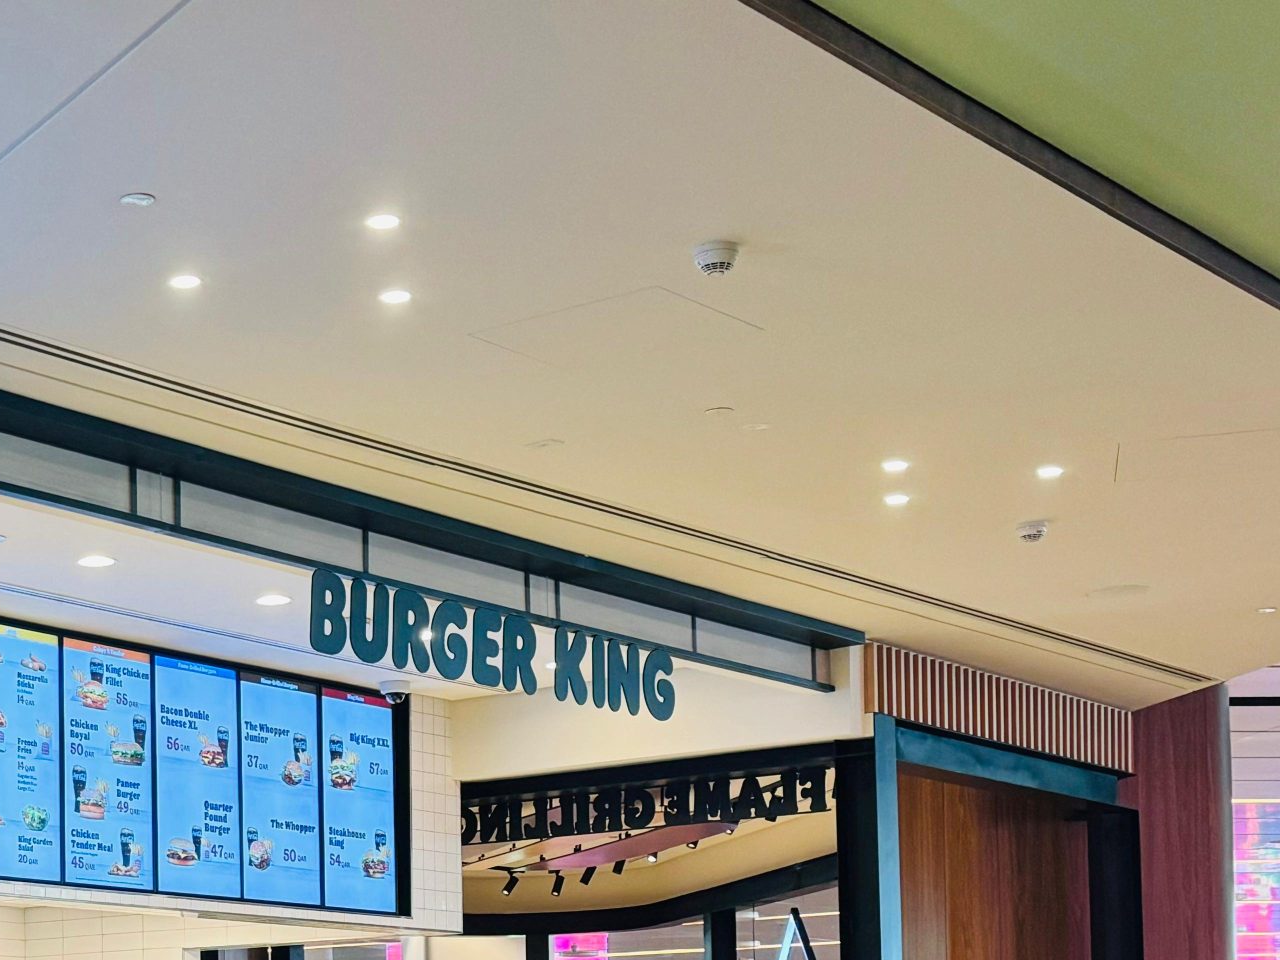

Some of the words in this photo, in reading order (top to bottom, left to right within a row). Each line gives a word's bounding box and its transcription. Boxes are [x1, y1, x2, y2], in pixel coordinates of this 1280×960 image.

[310, 568, 537, 695] BURGER
[555, 626, 675, 721] KING
[105, 664, 121, 677] King
[122, 667, 149, 680] Chicken
[105, 676, 122, 688] Fillet
[116, 692, 129, 706] 55
[160, 704, 184, 717] Bacon
[184, 707, 210, 721] Double
[70, 718, 99, 731] Chicken
[160, 715, 187, 728] Cheese
[188, 719, 198, 730] XL
[244, 720, 258, 732] The
[258, 722, 290, 737] Whopper
[70, 729, 90, 741] Royal
[244, 731, 269, 744] Junior
[349, 732, 361, 745] Big
[361, 734, 376, 748] King
[70, 743, 84, 756] 50
[166, 736, 180, 751] 56
[247, 754, 259, 768] 37
[369, 761, 380, 776] 57
[116, 778, 141, 790] Paneer
[116, 788, 141, 801] Burger
[116, 800, 129, 813] 49
[204, 800, 234, 813] Quarter
[71, 828, 100, 840] Chicken
[204, 823, 231, 837] Burger
[270, 819, 284, 830] The
[285, 820, 316, 835] Whopper
[328, 826, 366, 840] Steakhouse
[18, 835, 32, 845] King
[71, 839, 96, 851] Tender
[97, 842, 114, 853] Meal
[328, 837, 345, 850] King
[18, 853, 28, 864] 20
[210, 844, 224, 859] 47
[283, 848, 297, 862] 50
[71, 855, 85, 869] 45
[329, 853, 341, 866] 54
